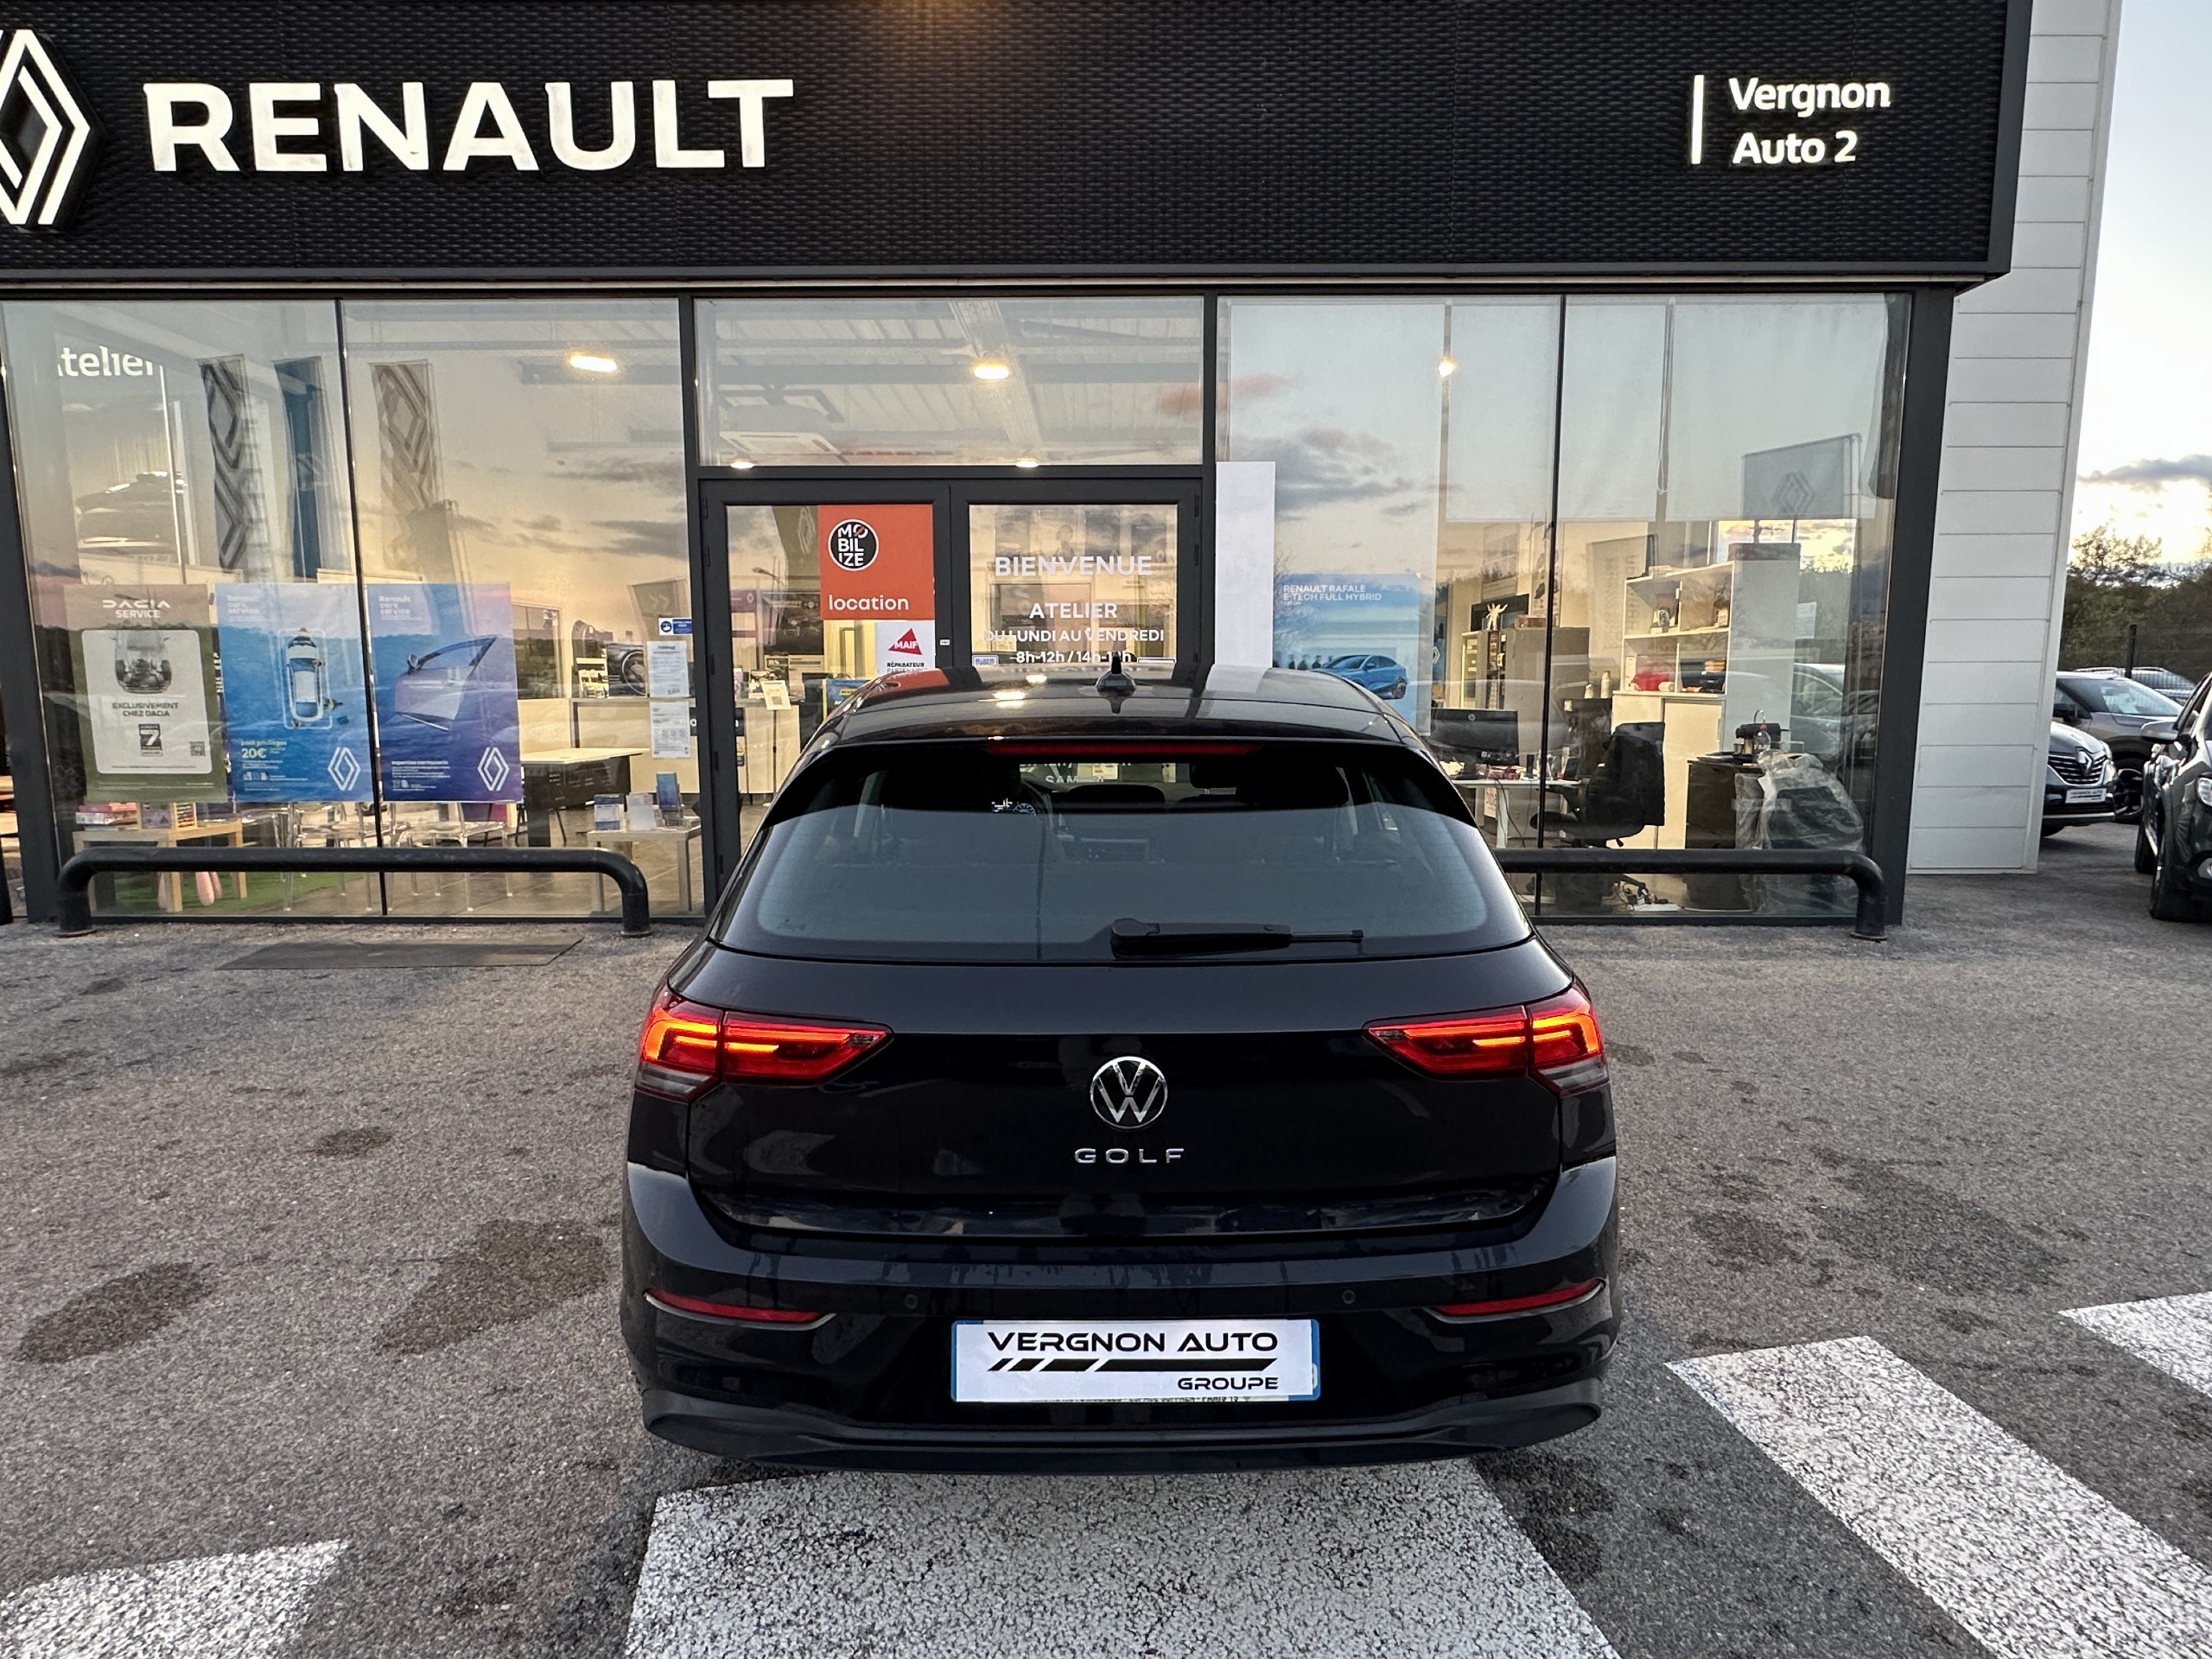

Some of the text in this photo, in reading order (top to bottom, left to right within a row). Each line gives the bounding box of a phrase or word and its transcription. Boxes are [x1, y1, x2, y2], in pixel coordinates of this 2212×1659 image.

[1729, 78, 1891, 118] Vergnon
[143, 79, 793, 171] RENAULT
[1732, 130, 1858, 164] Auto 2
[58, 346, 153, 377] telier
[837, 538, 864, 552] BIL
[838, 552, 864, 567] IZE
[995, 556, 1153, 576] BIENVENUE
[102, 600, 171, 608] DACIA
[829, 594, 909, 611] location
[1283, 593, 1318, 601] E-TECH
[1345, 593, 1382, 601] HYBRID
[115, 609, 161, 619] SERVICE
[1029, 602, 1118, 619] ATELIER
[983, 629, 1164, 641] DU LUNDI AU VENDREDI
[894, 640, 918, 650] MAIF
[1015, 651, 1065, 664] 8h-12h
[1076, 651, 1131, 663] 14h-1h
[241, 747, 267, 759] 20€
[1074, 1147, 1185, 1164] GOLF
[987, 1332, 1279, 1352] VERGNON AUTO
[1178, 1376, 1279, 1390] GROUPE
